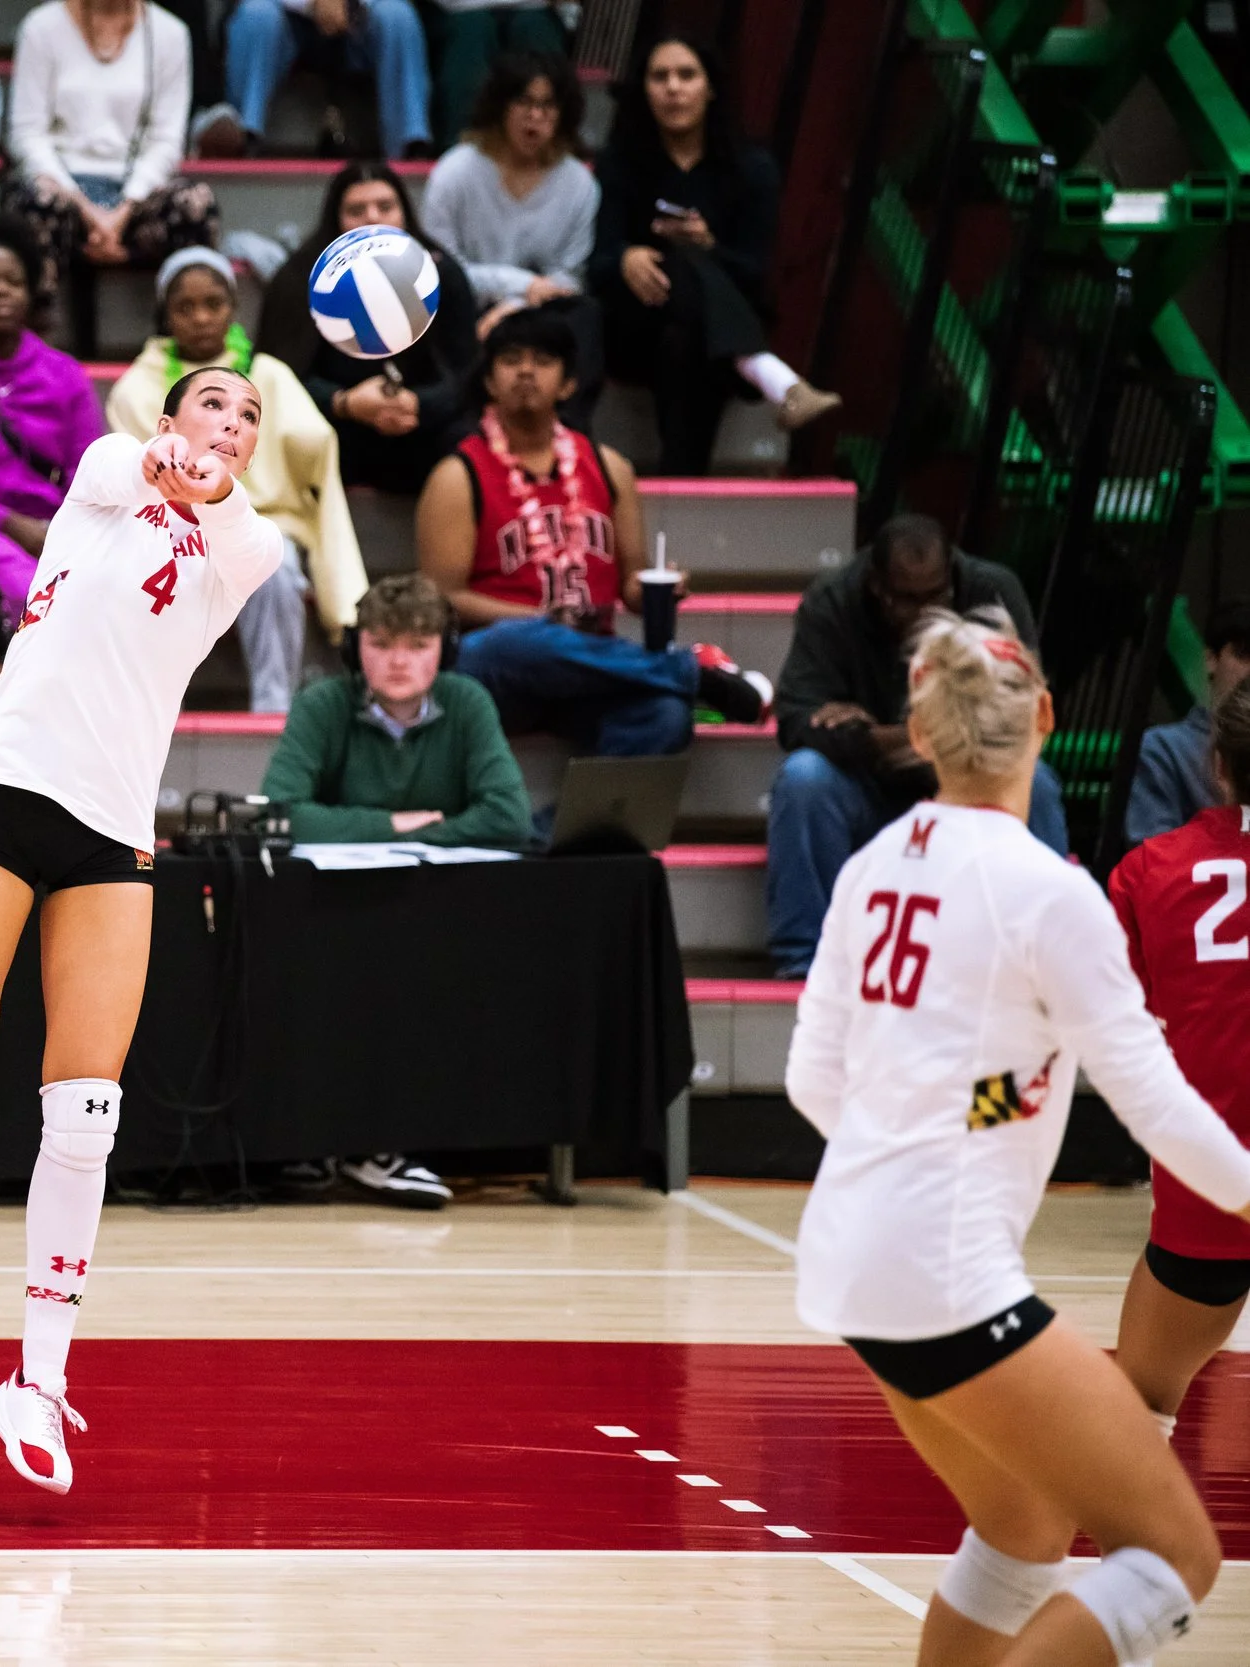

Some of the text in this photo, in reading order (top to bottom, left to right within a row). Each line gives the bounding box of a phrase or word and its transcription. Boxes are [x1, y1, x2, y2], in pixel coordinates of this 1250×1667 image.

[141, 558, 178, 616] 4
[903, 817, 938, 858] M
[860, 890, 941, 1009] 26
